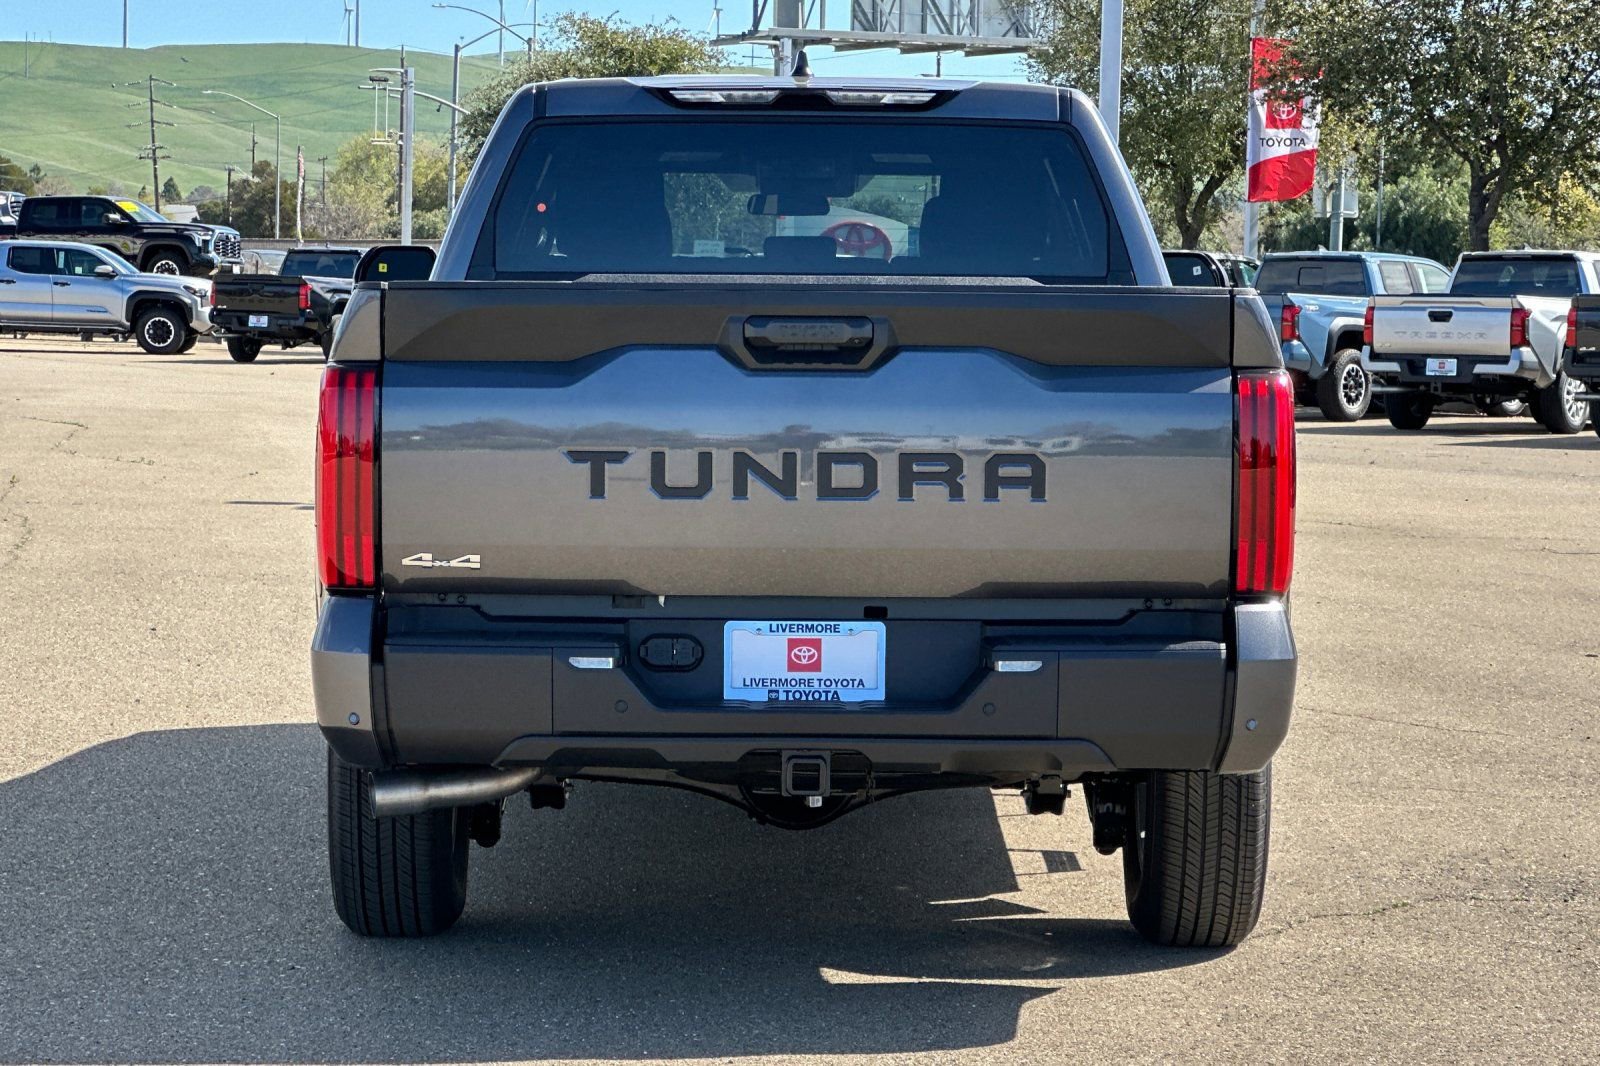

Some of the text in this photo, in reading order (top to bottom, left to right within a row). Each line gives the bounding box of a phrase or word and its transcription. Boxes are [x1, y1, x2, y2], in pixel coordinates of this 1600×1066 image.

[1260, 137, 1306, 147] TOYOTA
[562, 449, 1047, 502] TUNDRA
[769, 623, 841, 634] LIVERMORE
[742, 678, 866, 688] LIVERMORE TOYOTA
[783, 690, 841, 701] TOYOTA
